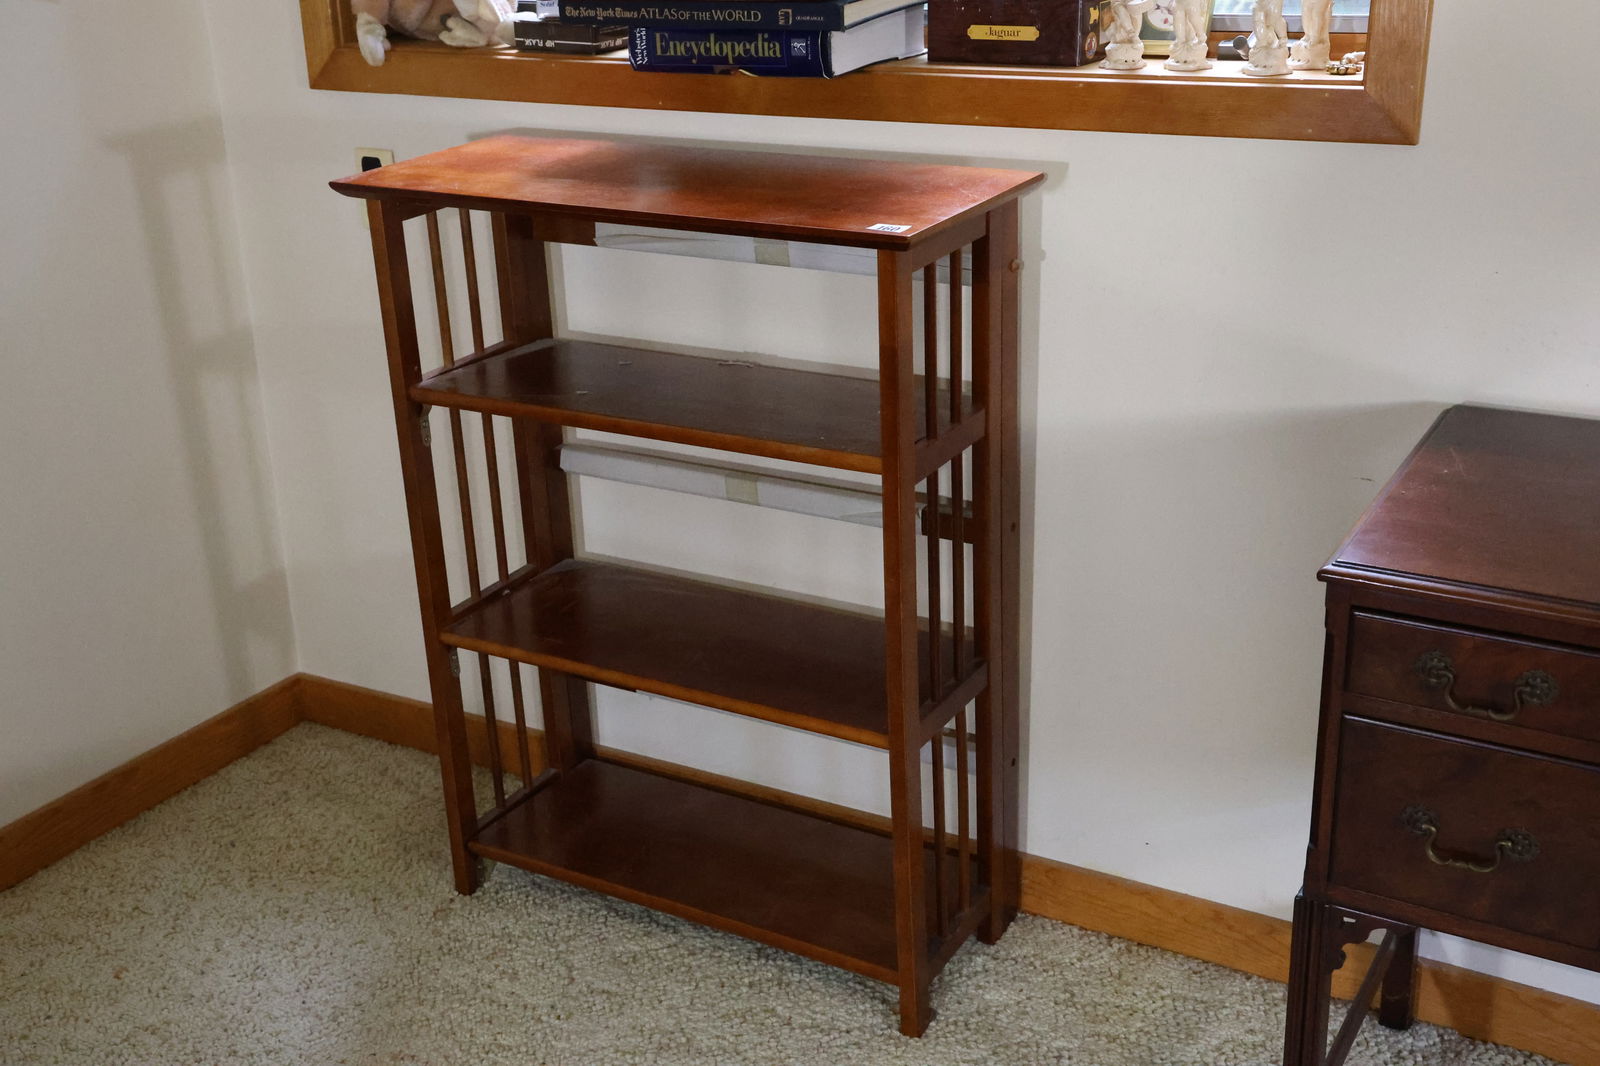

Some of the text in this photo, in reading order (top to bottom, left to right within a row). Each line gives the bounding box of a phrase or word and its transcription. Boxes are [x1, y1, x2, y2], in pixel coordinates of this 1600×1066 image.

[565, 6, 761, 22] The New York Times ATLAS OF THE WORLD
[985, 27, 1021, 37] Jaguar
[524, 38, 555, 48] HIP FLASK
[600, 40, 614, 49] FLASK
[655, 31, 782, 64] Encyclopedia
